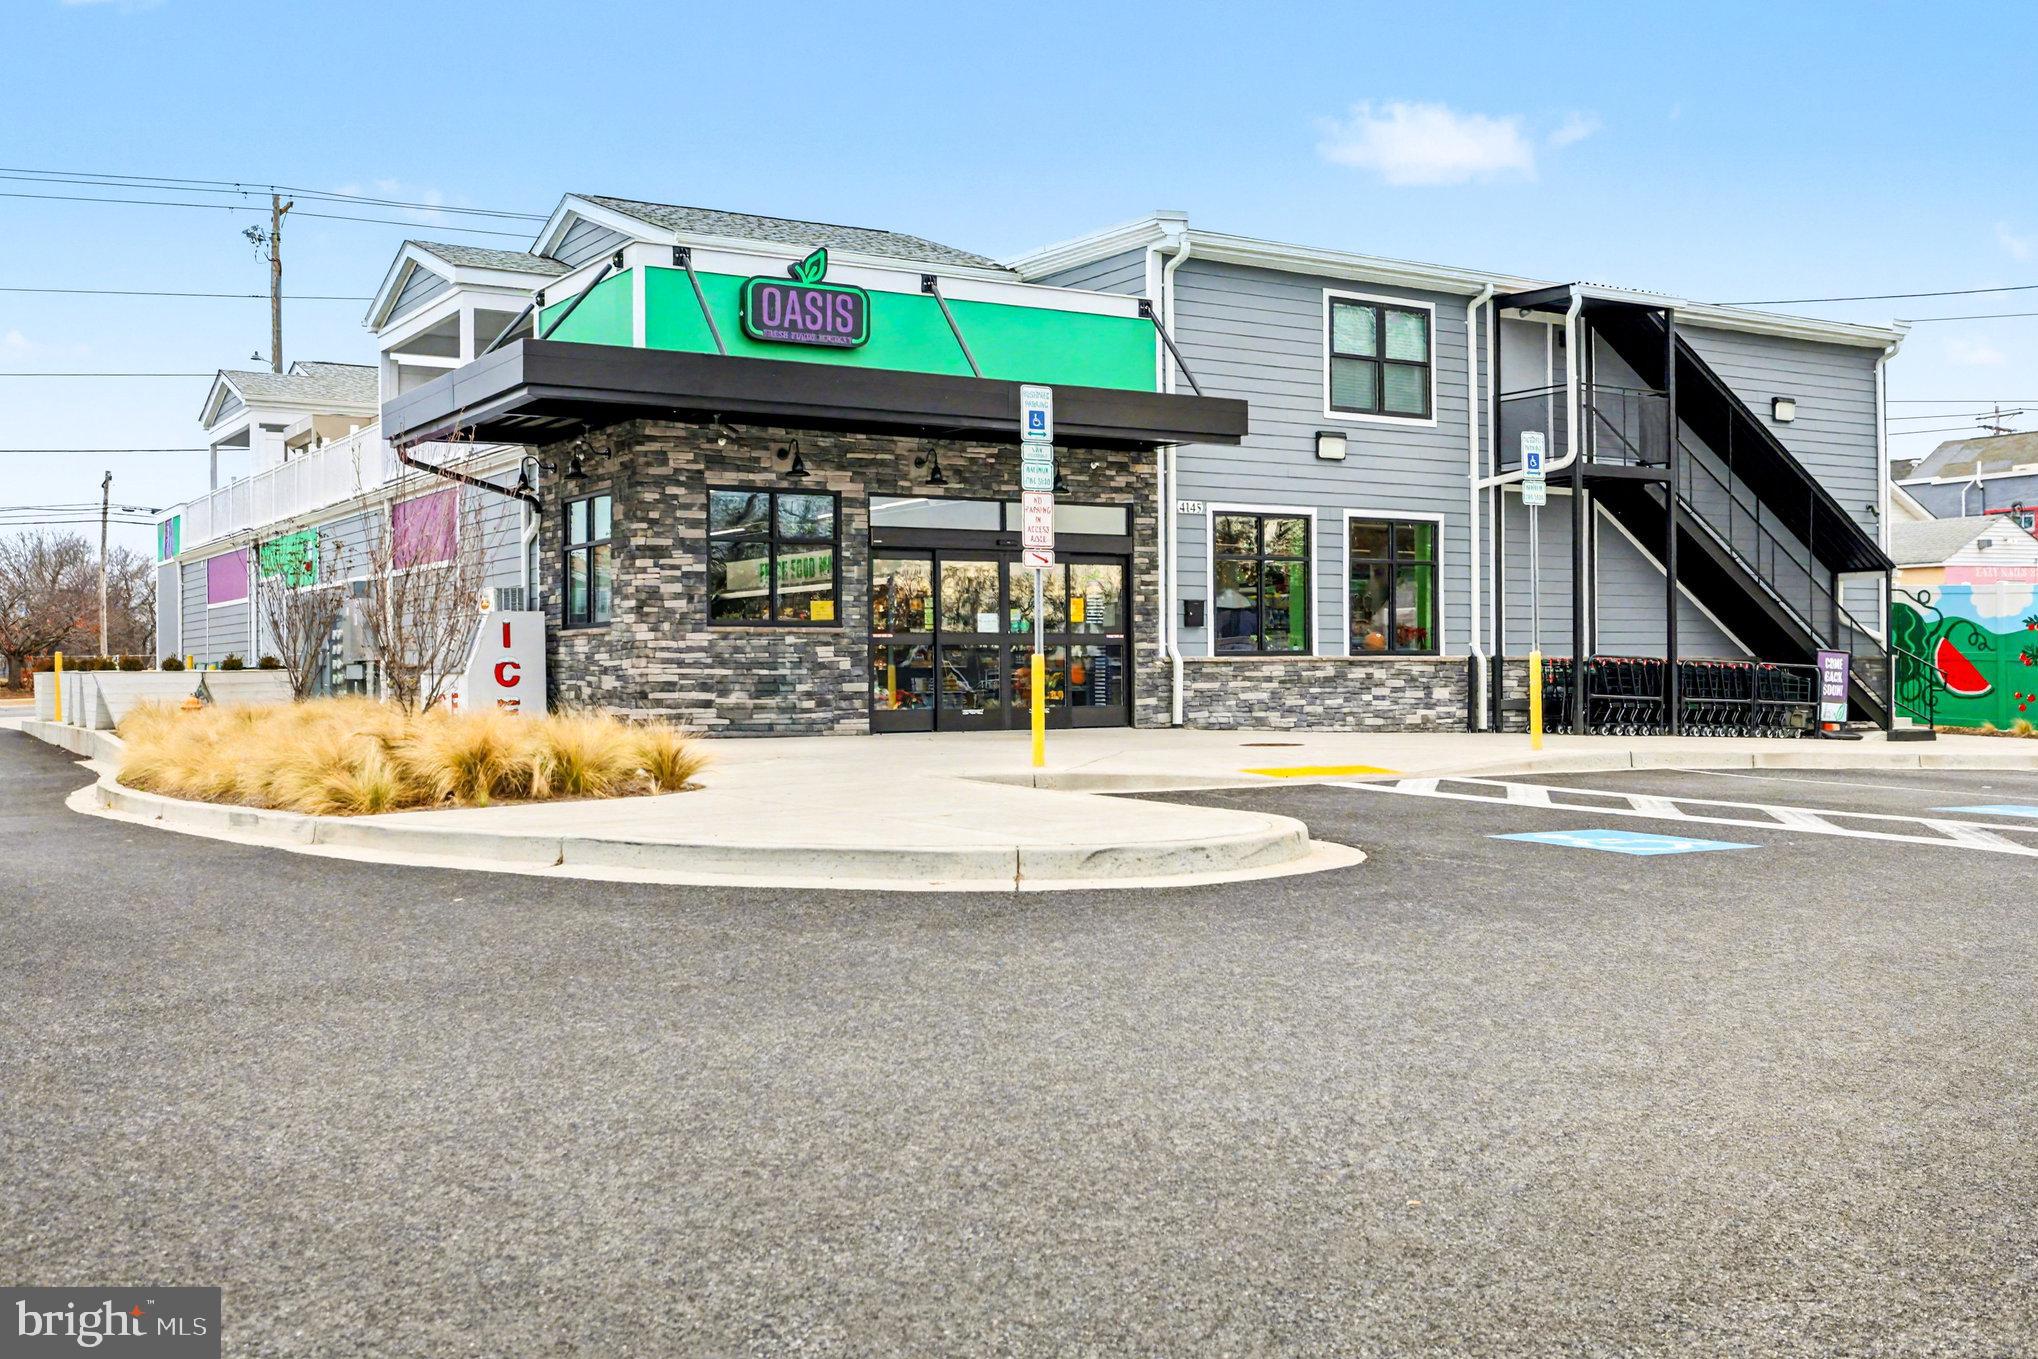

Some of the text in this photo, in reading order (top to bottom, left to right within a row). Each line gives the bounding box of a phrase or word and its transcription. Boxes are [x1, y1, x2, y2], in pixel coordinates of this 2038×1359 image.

[762, 287, 853, 333] OASIS
[1179, 502, 1201, 513] 4145
[1825, 657, 1843, 670] COME
[1822, 684, 1844, 697] SOON
